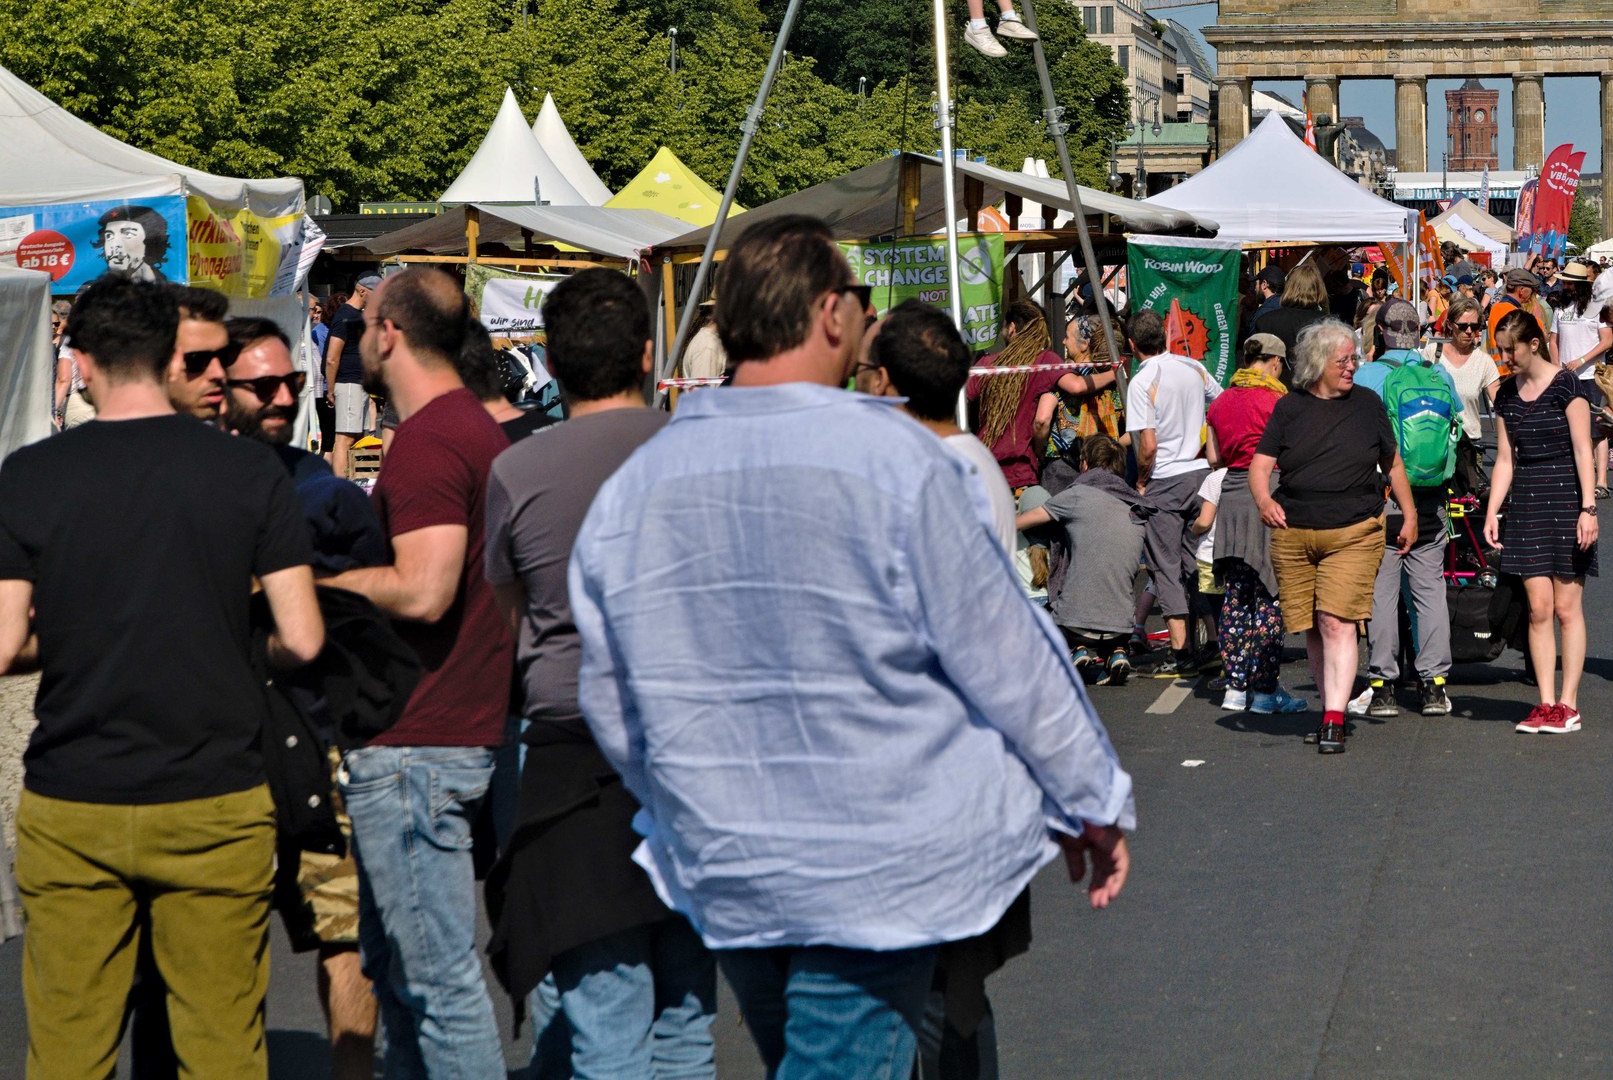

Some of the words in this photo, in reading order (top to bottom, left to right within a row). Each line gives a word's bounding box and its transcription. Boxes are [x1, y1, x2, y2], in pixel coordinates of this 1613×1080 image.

[22, 256, 40, 268] ab
[42, 254, 58, 266] 18
[60, 253, 71, 266] €
[863, 245, 946, 266] SYSTEM
[1143, 258, 1184, 272] ROBIN
[1184, 260, 1224, 274] WOOD
[863, 266, 948, 287] CHANGE
[919, 289, 948, 302] NOT
[1149, 282, 1168, 302] FÜR
[490, 317, 509, 326] wir
[510, 318, 535, 328] sind
[1213, 302, 1228, 331] GEGEN
[1214, 332, 1230, 387] ATOMKRAF
